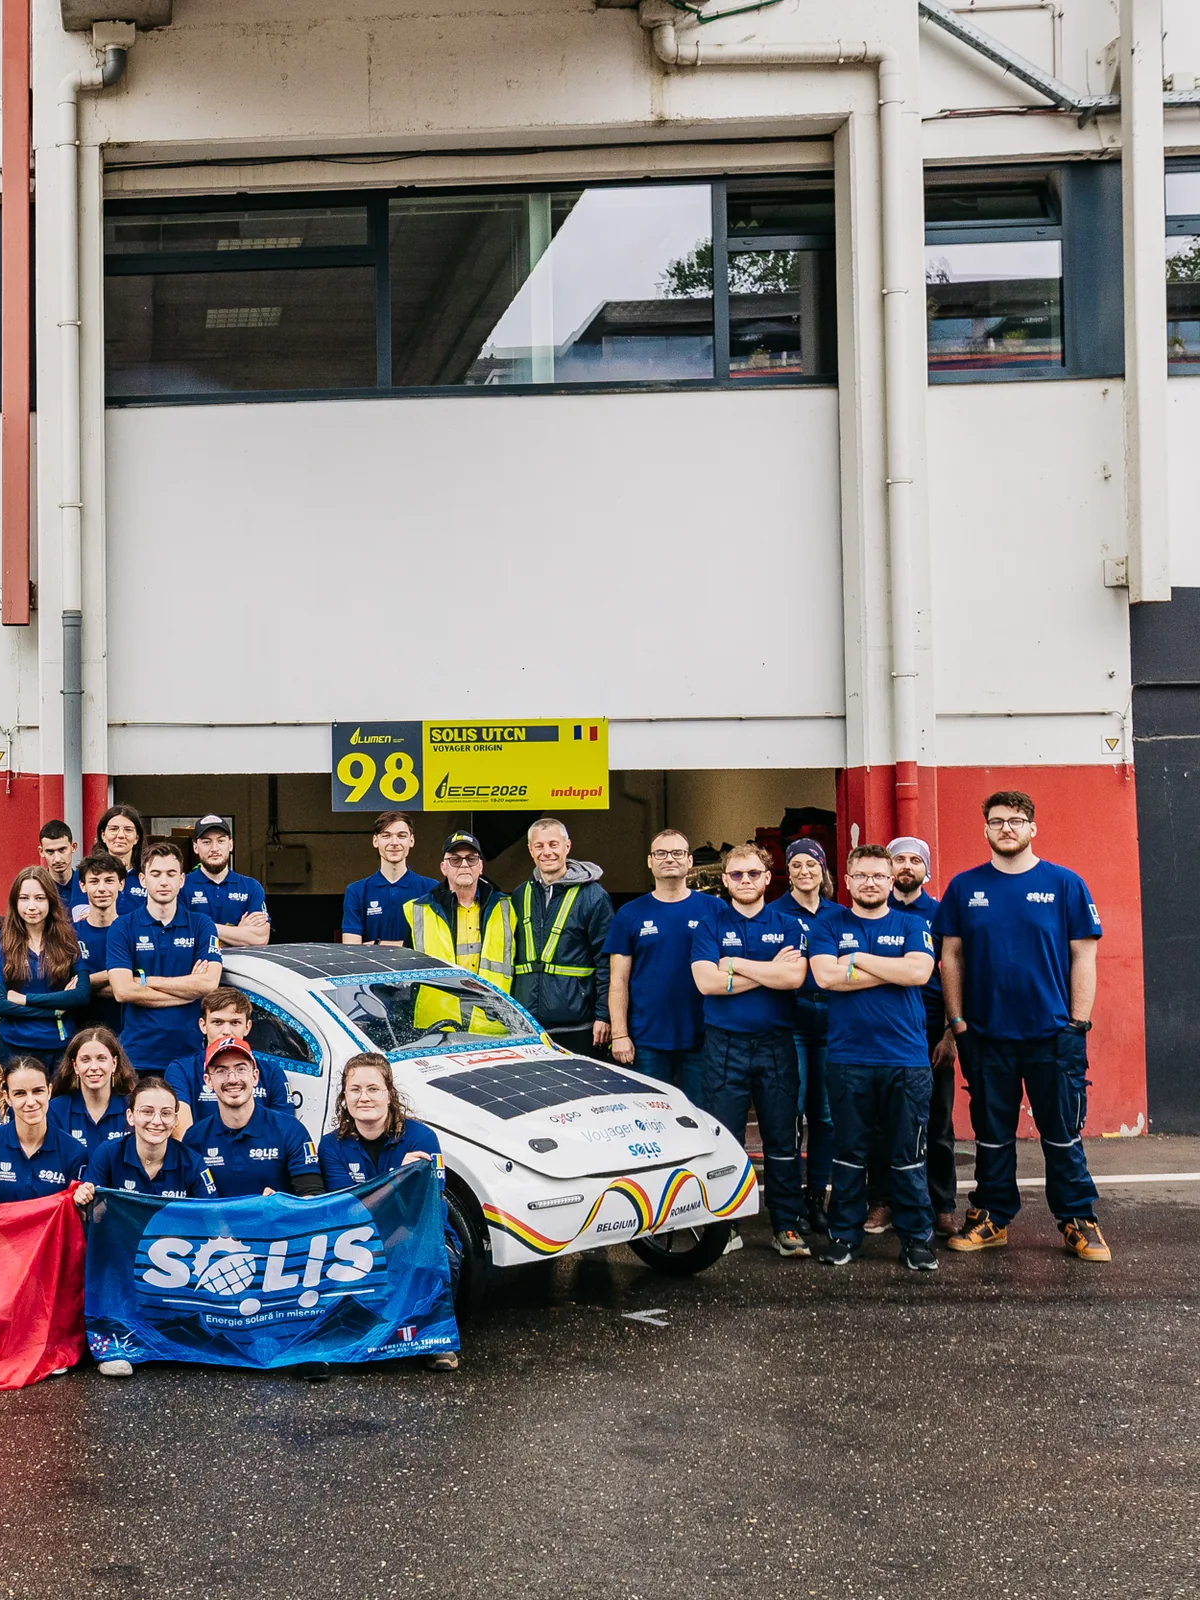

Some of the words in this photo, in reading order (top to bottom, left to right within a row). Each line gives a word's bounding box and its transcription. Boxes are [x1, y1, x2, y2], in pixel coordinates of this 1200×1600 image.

[431, 728, 478, 742] SOLIS
[481, 727, 526, 741] UTCN
[433, 744, 471, 752] VOYAGER
[473, 744, 503, 752] ORIGIN
[337, 752, 420, 803] 98
[551, 786, 603, 800] indupol
[129, 885, 147, 898] SOLI
[228, 892, 249, 903] SOLIS
[1026, 892, 1056, 904] SOLIS
[761, 933, 785, 944] SOLI
[877, 935, 905, 947] SOLIS
[646, 1101, 672, 1111] BOSCH
[581, 1122, 633, 1143] Voyager
[635, 1119, 666, 1133] Origin
[249, 1148, 279, 1160] SOLIS
[628, 1141, 661, 1155] SOLIS
[670, 1200, 701, 1218] ROMANIA
[596, 1218, 637, 1233] BELGIUM
[142, 1225, 375, 1296] SOLIS
[205, 1314, 243, 1327] Energie
